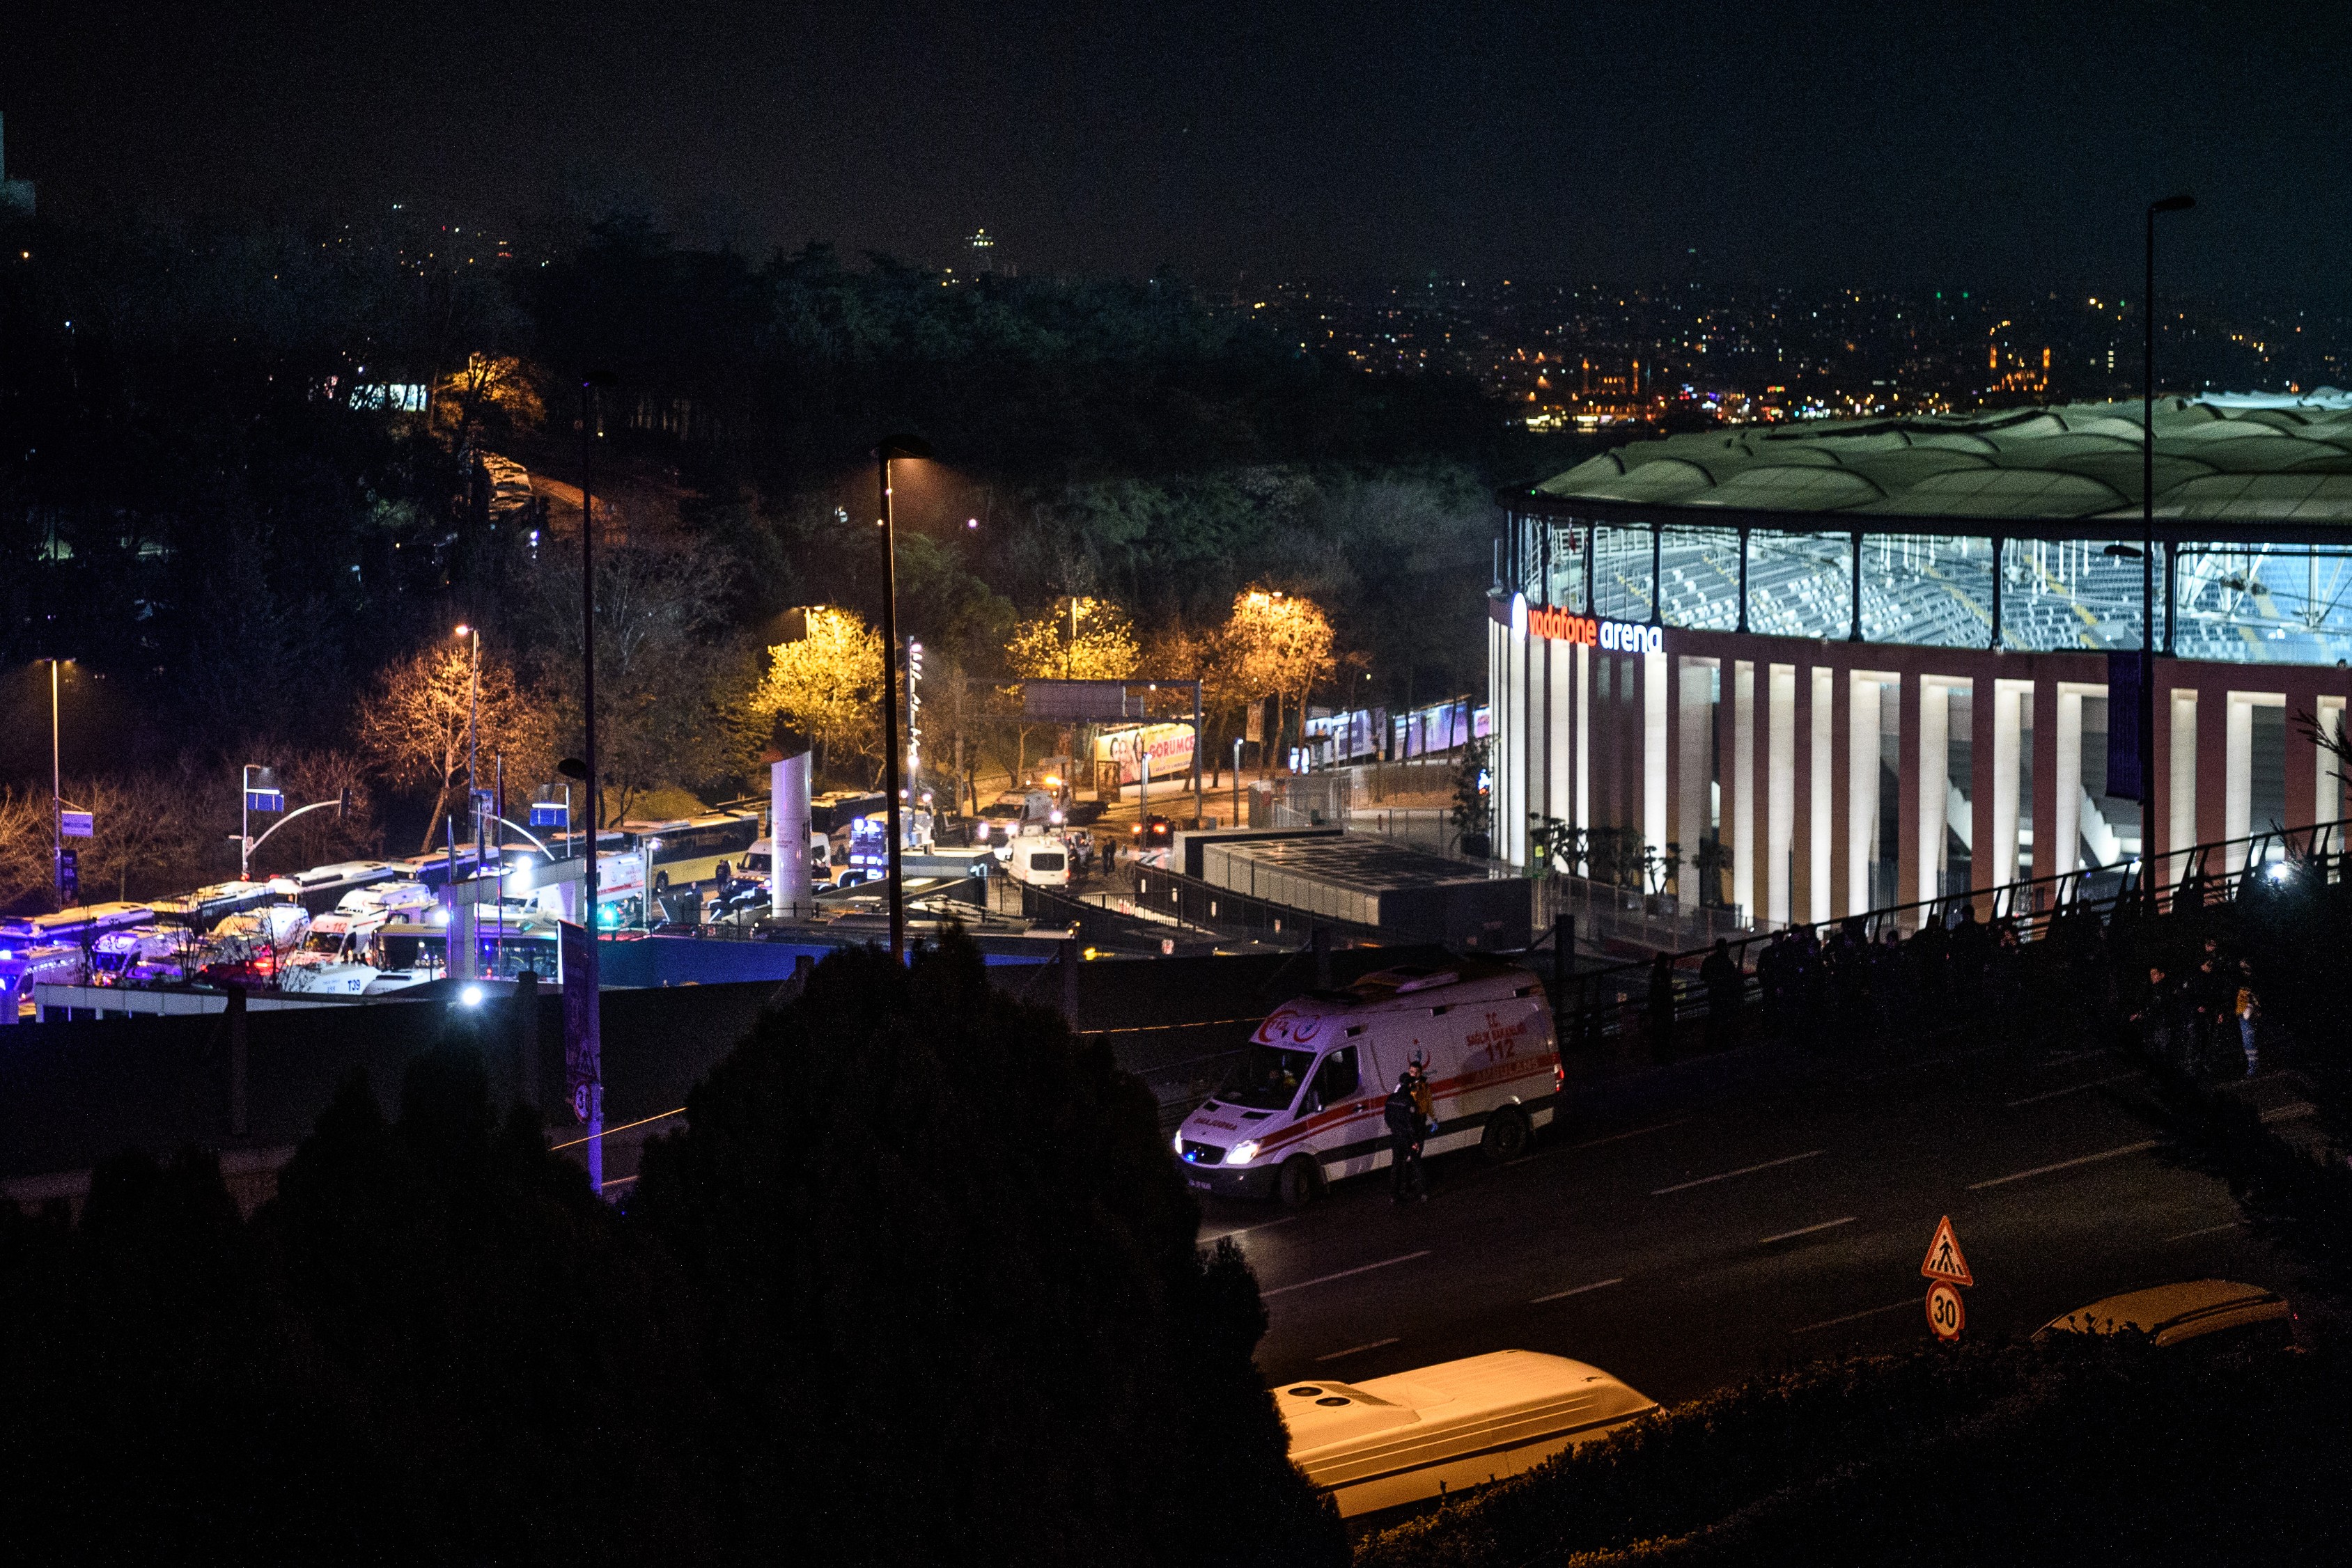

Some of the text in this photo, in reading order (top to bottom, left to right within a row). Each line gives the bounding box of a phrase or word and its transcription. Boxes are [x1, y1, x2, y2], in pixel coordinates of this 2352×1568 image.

[1528, 604, 1662, 654] vodafone arena
[348, 979, 361, 991] T39
[1485, 1039, 1515, 1061] 112
[1934, 1295, 1956, 1328] 30
